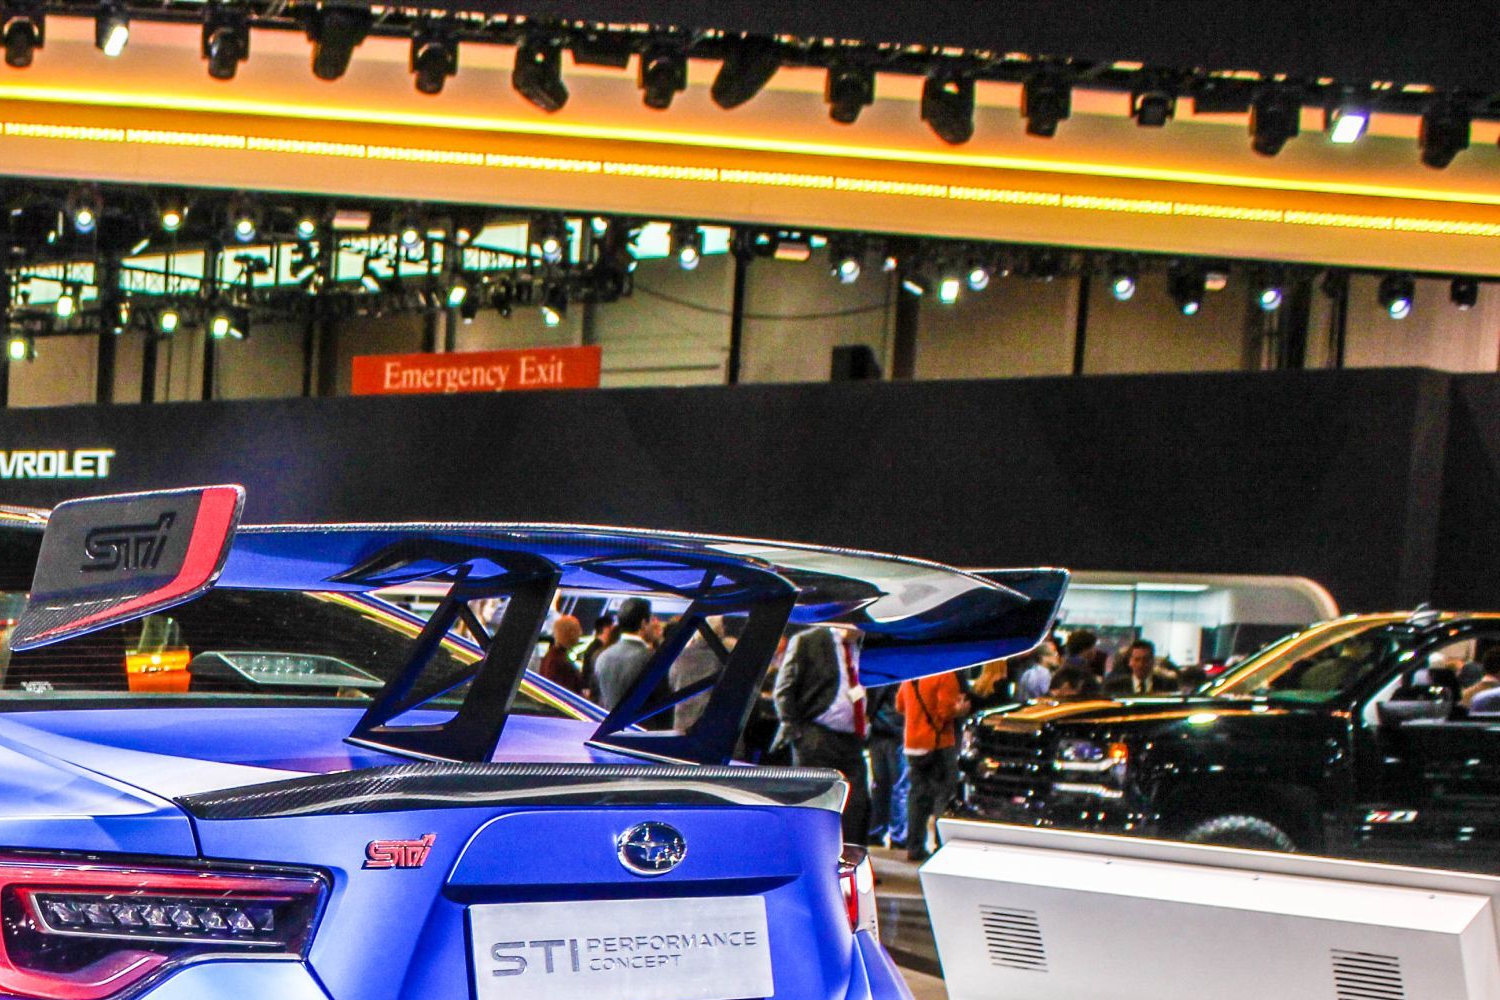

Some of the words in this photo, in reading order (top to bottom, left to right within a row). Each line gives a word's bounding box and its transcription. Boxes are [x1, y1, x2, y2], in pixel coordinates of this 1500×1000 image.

[383, 361, 511, 392] Emergency
[519, 355, 564, 385] Exit
[489, 938, 581, 977] STI
[586, 931, 758, 953] PERFORMANCE
[588, 954, 683, 971] CONCEPT
